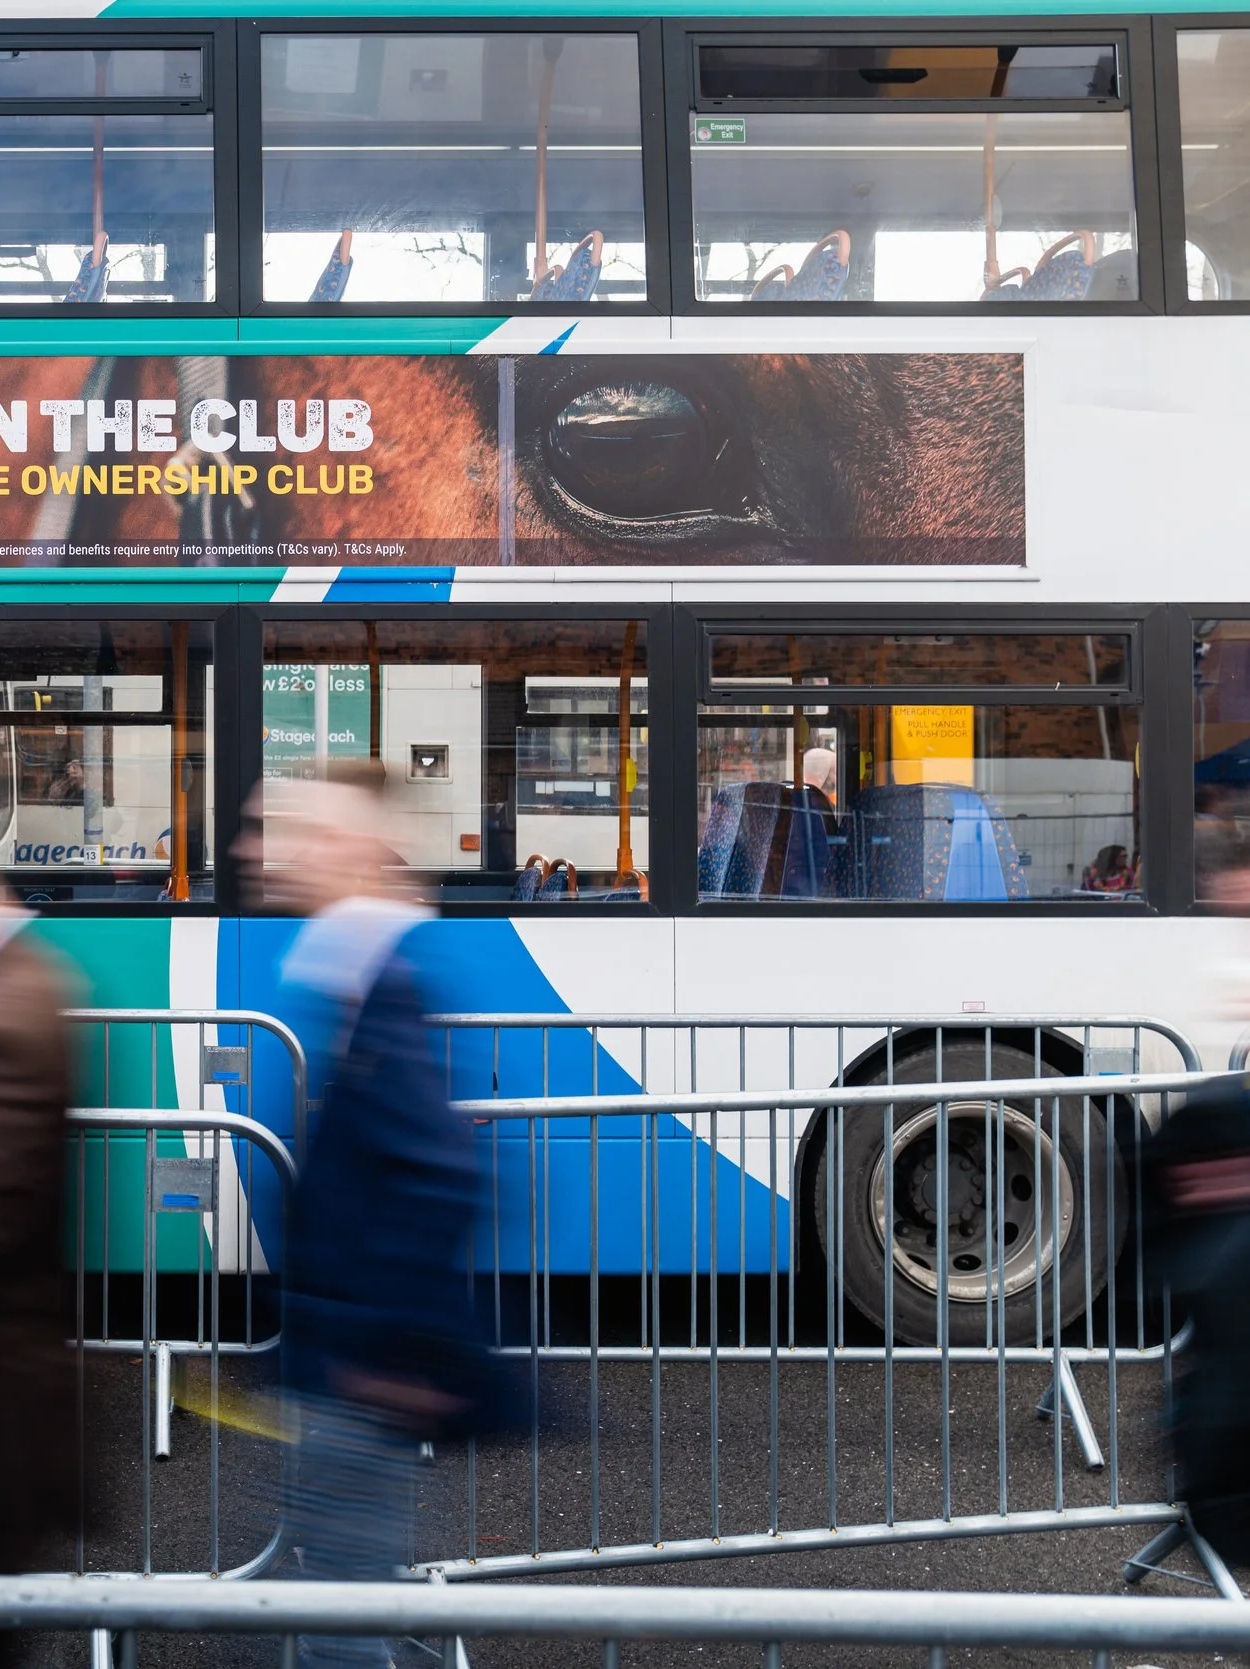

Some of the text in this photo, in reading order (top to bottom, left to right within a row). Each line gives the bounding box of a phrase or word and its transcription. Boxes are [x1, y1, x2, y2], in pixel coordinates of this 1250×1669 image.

[710, 122, 744, 132] Emergency
[721, 131, 734, 139] Exit
[39, 399, 178, 453] THE
[188, 397, 374, 453] CLUB
[21, 464, 258, 496] OWNERSHIP
[266, 464, 374, 495] CLUB
[46, 544, 66, 555] and
[69, 544, 111, 555] benefits
[114, 544, 150, 558] require
[152, 545, 179, 557] entry
[182, 544, 202, 555] into
[205, 543, 274, 557] competitions
[277, 543, 309, 557] (T&Cs
[311, 543, 341, 557] vary).
[344, 543, 373, 555] T&Cs
[375, 543, 407, 557] Apply.
[278, 675, 302, 691] £2
[329, 675, 365, 691] less
[894, 707, 967, 716] EMERGENCY EXIT
[908, 720, 967, 729] PULL HANDLE
[270, 728, 355, 745] Stageach
[907, 730, 967, 738] & PUSH DOOR
[86, 851, 96, 860] 13
